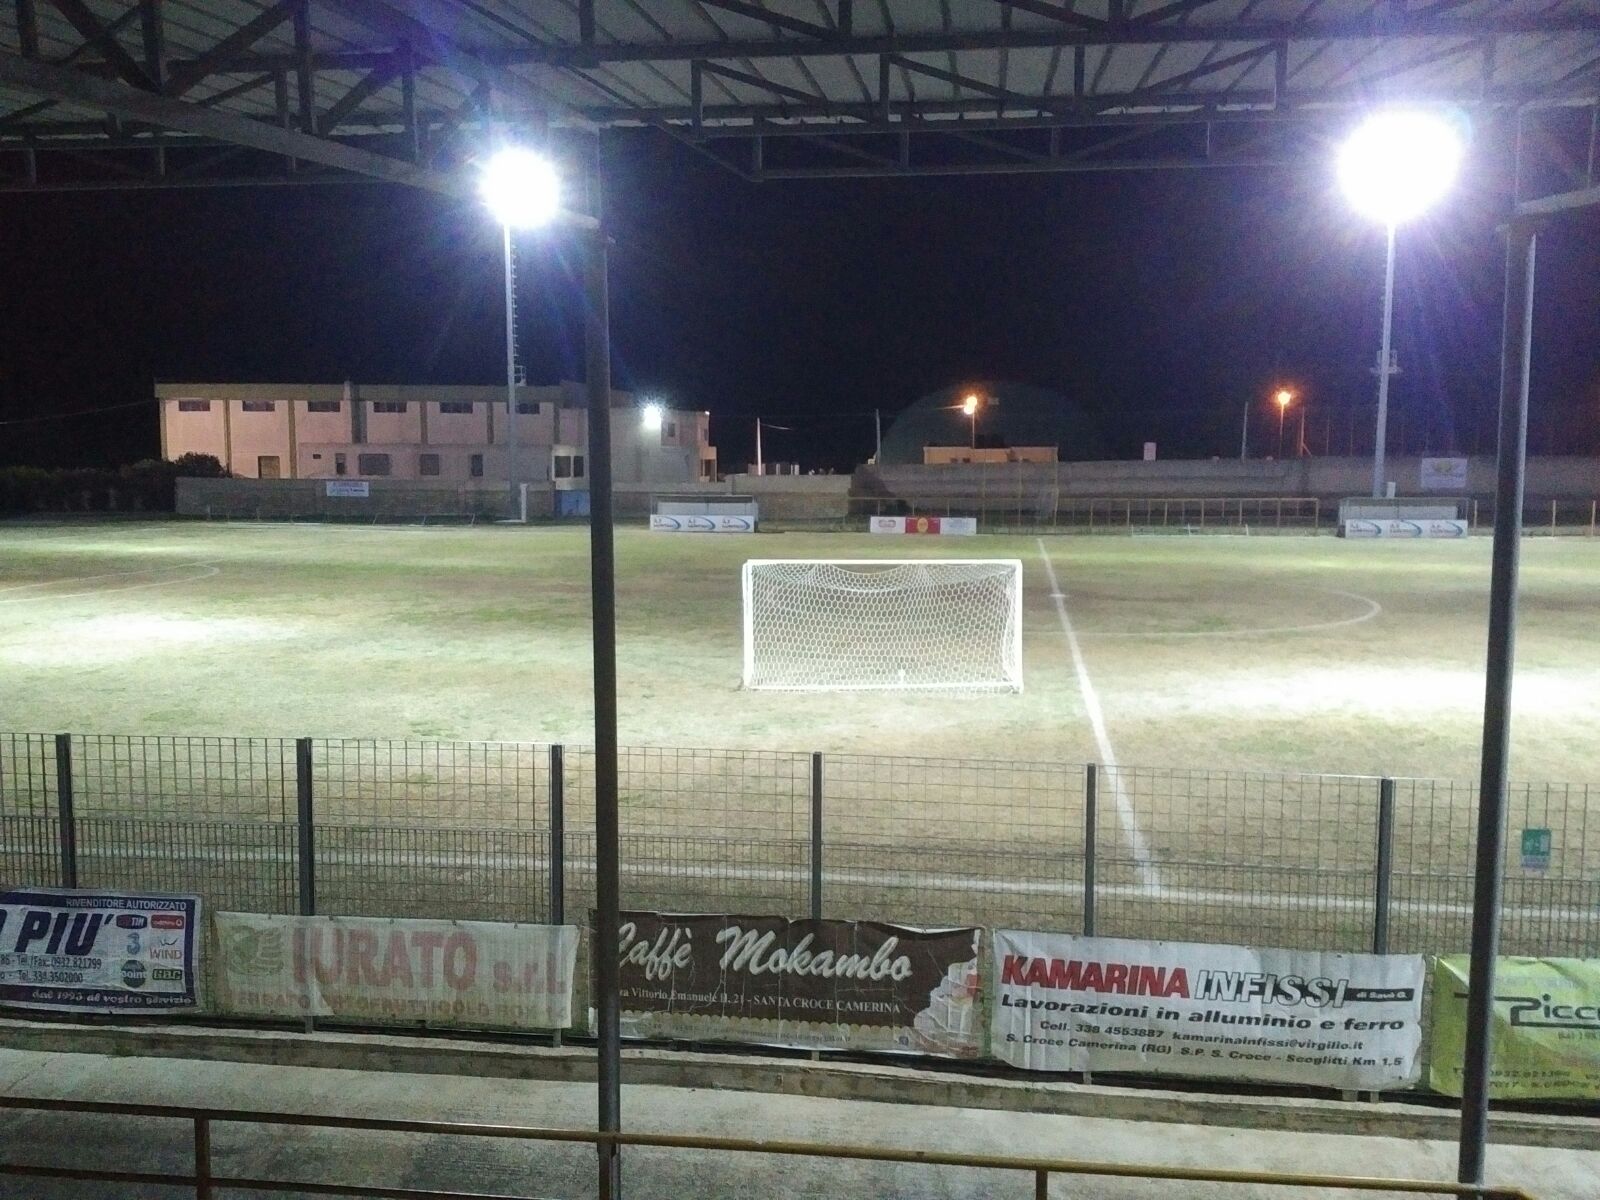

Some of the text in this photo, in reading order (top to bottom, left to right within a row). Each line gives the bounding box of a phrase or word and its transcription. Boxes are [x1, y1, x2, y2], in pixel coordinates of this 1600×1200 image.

[66, 898, 187, 910] RIVENDITORE AUTORIZZATO
[149, 947, 183, 959] WIND
[716, 926, 913, 981] Mokambo
[1001, 954, 1190, 998] KAMARINA
[1194, 969, 1349, 1009] INFISSI
[103, 994, 142, 1004] vostro
[631, 987, 667, 999] Vittorio
[671, 990, 717, 1003] Emanuele
[753, 995, 791, 1007] SANTA
[793, 999, 832, 1010] CROCE
[837, 1000, 900, 1013] CAMERINA
[1002, 994, 1405, 1030] Lavorazioni in alluminio e ferro
[1453, 992, 1600, 1029] Picc
[1023, 1034, 1064, 1047] Croce
[1069, 1038, 1137, 1052] Camerina
[1141, 1043, 1172, 1055] (RG)
[1228, 1050, 1271, 1061] Croce
[1287, 1054, 1348, 1066] Scoglitti
[1352, 1056, 1376, 1067] Km
[1040, 1021, 1070, 1031] Cell.
[1172, 1032, 1363, 1051] kamarinainfissi@virgilio.it
